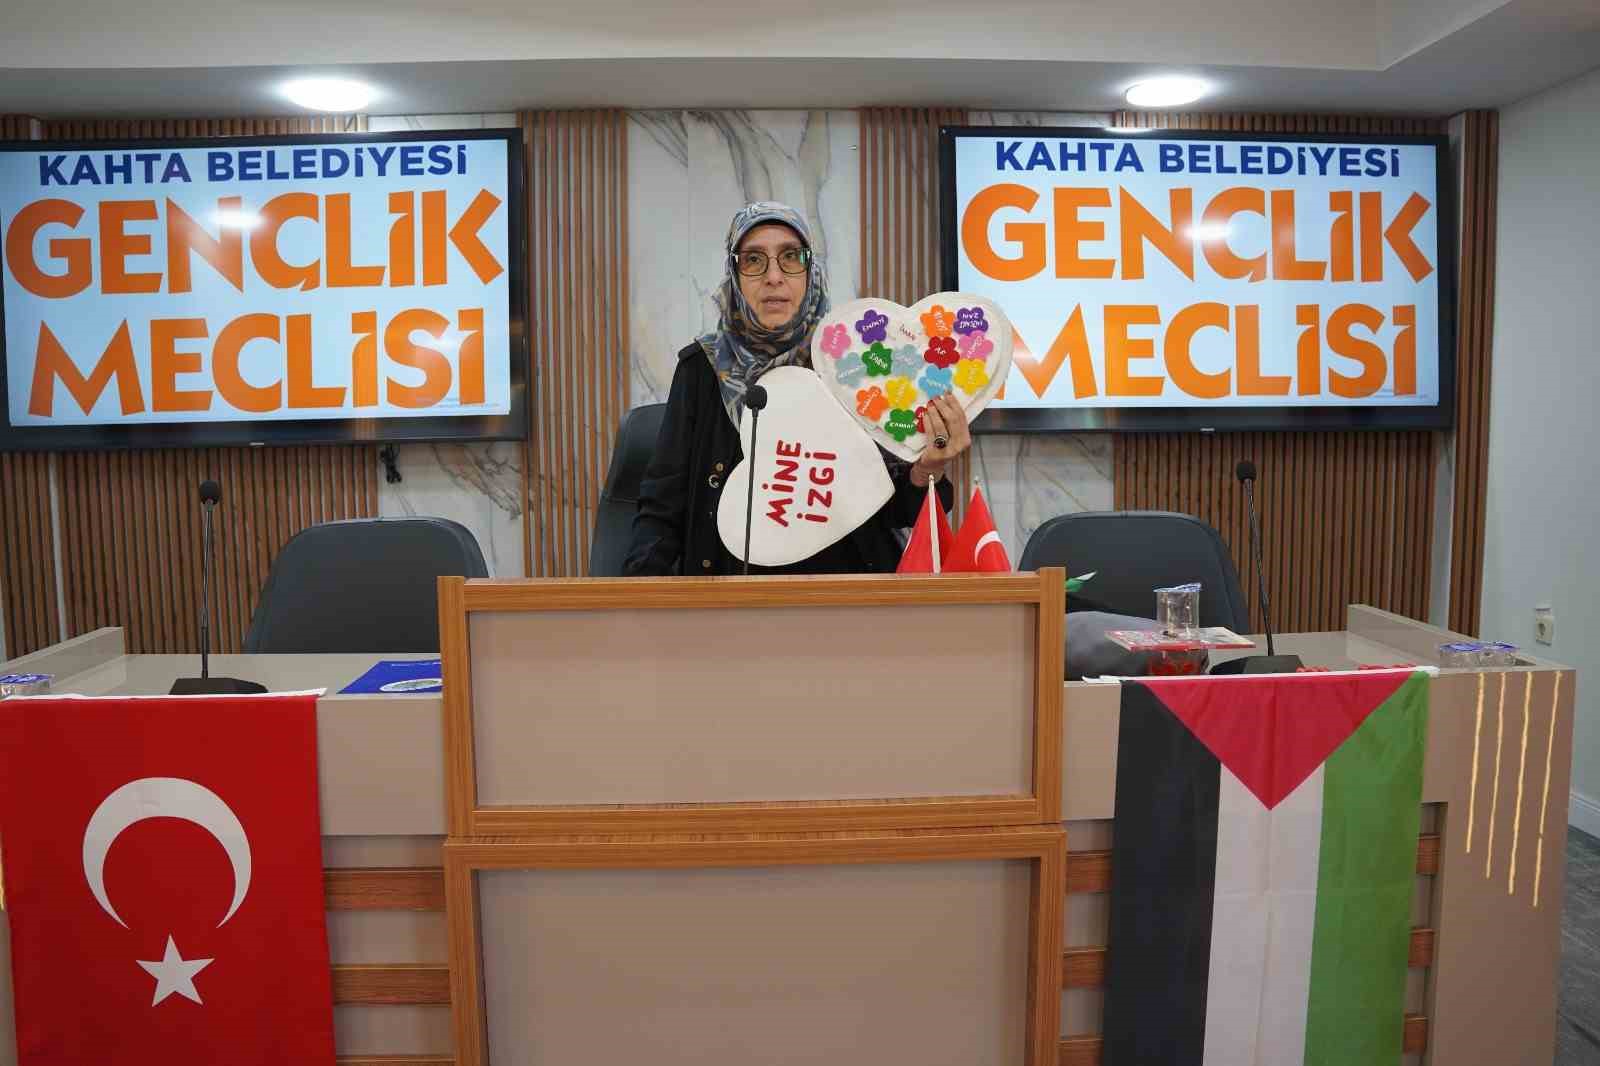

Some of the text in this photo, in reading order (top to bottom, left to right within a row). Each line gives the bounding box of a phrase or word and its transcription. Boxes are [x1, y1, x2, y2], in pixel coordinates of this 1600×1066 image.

[39, 144, 467, 185] KAHTA BELEDİYESİ
[996, 141, 1400, 177] KAHTA BELEDİYESİ
[6, 188, 504, 298] GENÇLİK
[961, 183, 1434, 283] GENÇLİK
[28, 307, 486, 417] MECLİSİ
[994, 302, 1417, 400] MECLİSİ
[762, 440, 801, 527] MİNE
[796, 452, 837, 523] İZGİ
